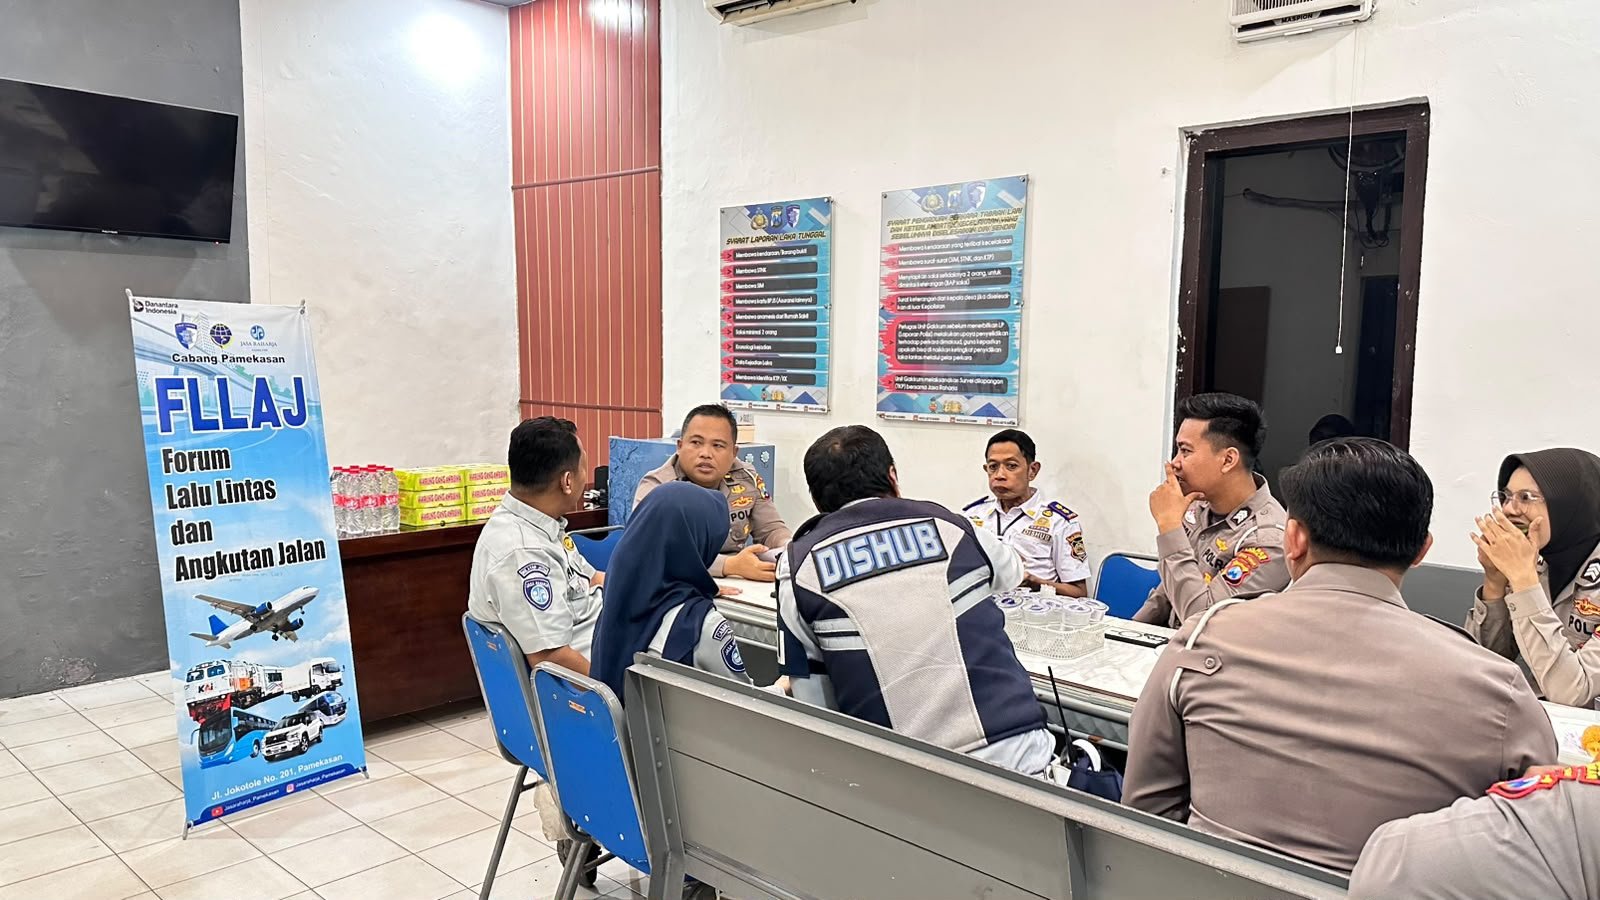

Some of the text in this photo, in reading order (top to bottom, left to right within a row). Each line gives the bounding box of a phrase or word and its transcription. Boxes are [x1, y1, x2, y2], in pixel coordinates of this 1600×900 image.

[1282, 14, 1312, 23] MASPION
[172, 353, 285, 364] Cabang Pamekasan
[154, 376, 308, 433] FLLAJ
[162, 448, 230, 474] Forum
[166, 479, 276, 510] Lalu Lintas
[730, 509, 752, 521] POL
[171, 520, 213, 546] dan
[175, 540, 326, 582] Angkutan Jalan
[818, 523, 944, 588] DISHUB
[1568, 615, 1594, 635] POL
[212, 792, 222, 801] Jl.
[225, 780, 262, 797] Jokotole
[264, 776, 277, 785] No.
[298, 754, 343, 773] Pamekasan
